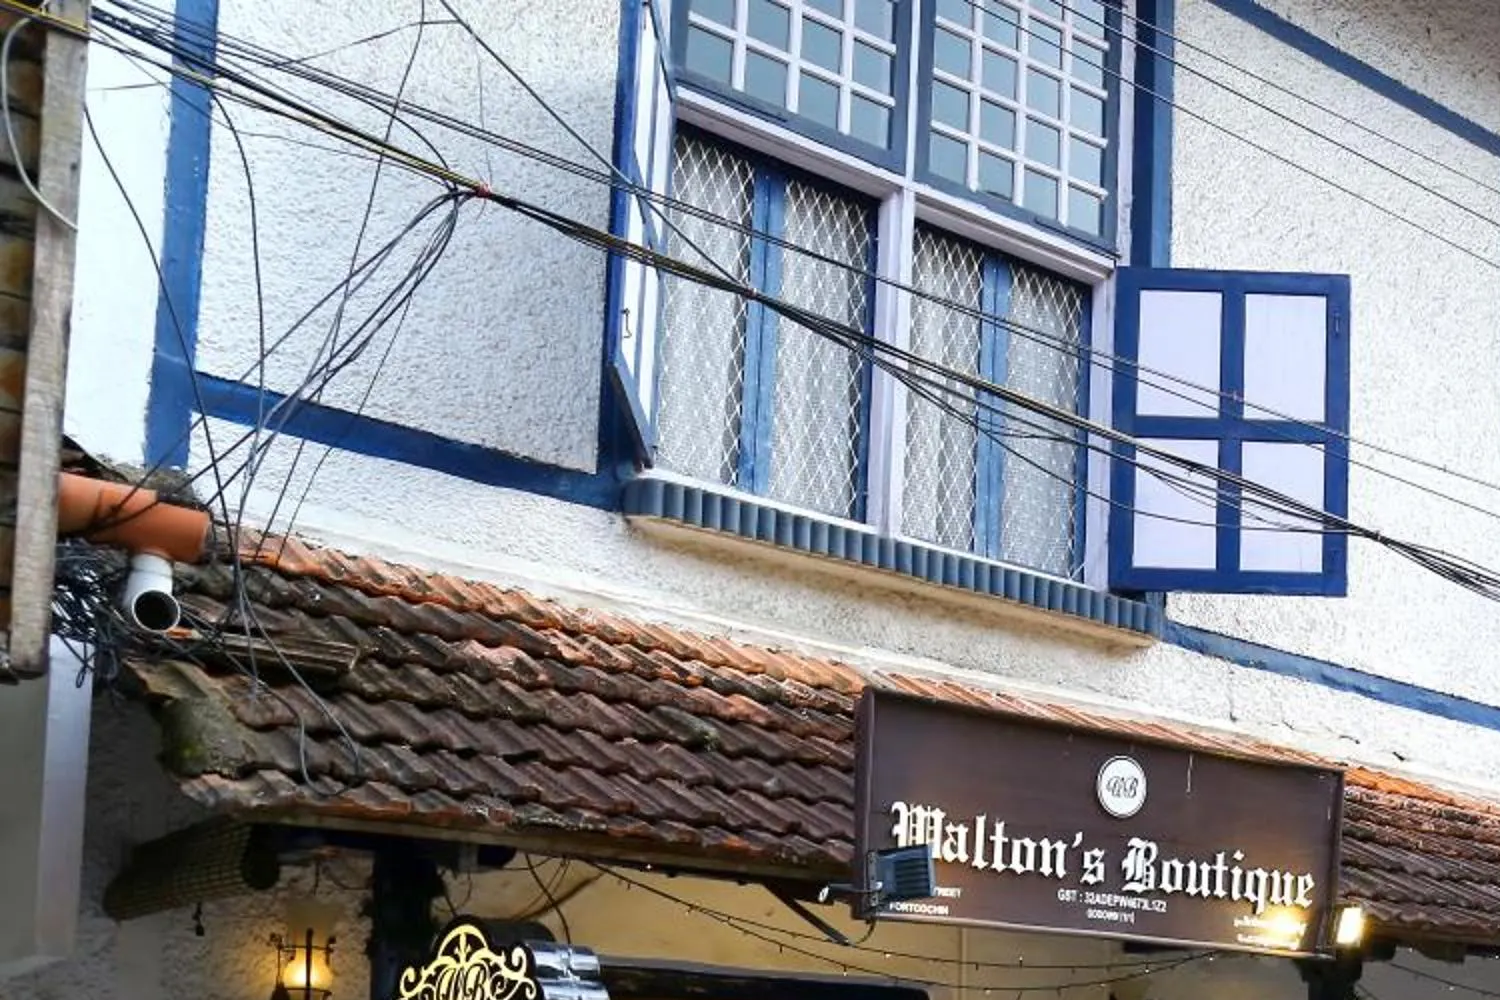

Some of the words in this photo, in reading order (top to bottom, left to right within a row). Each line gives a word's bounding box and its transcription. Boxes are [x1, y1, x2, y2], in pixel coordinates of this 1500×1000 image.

[891, 801, 1106, 885] Walton's
[1122, 836, 1316, 915] Boutique
[1057, 887, 1077, 902] GST
